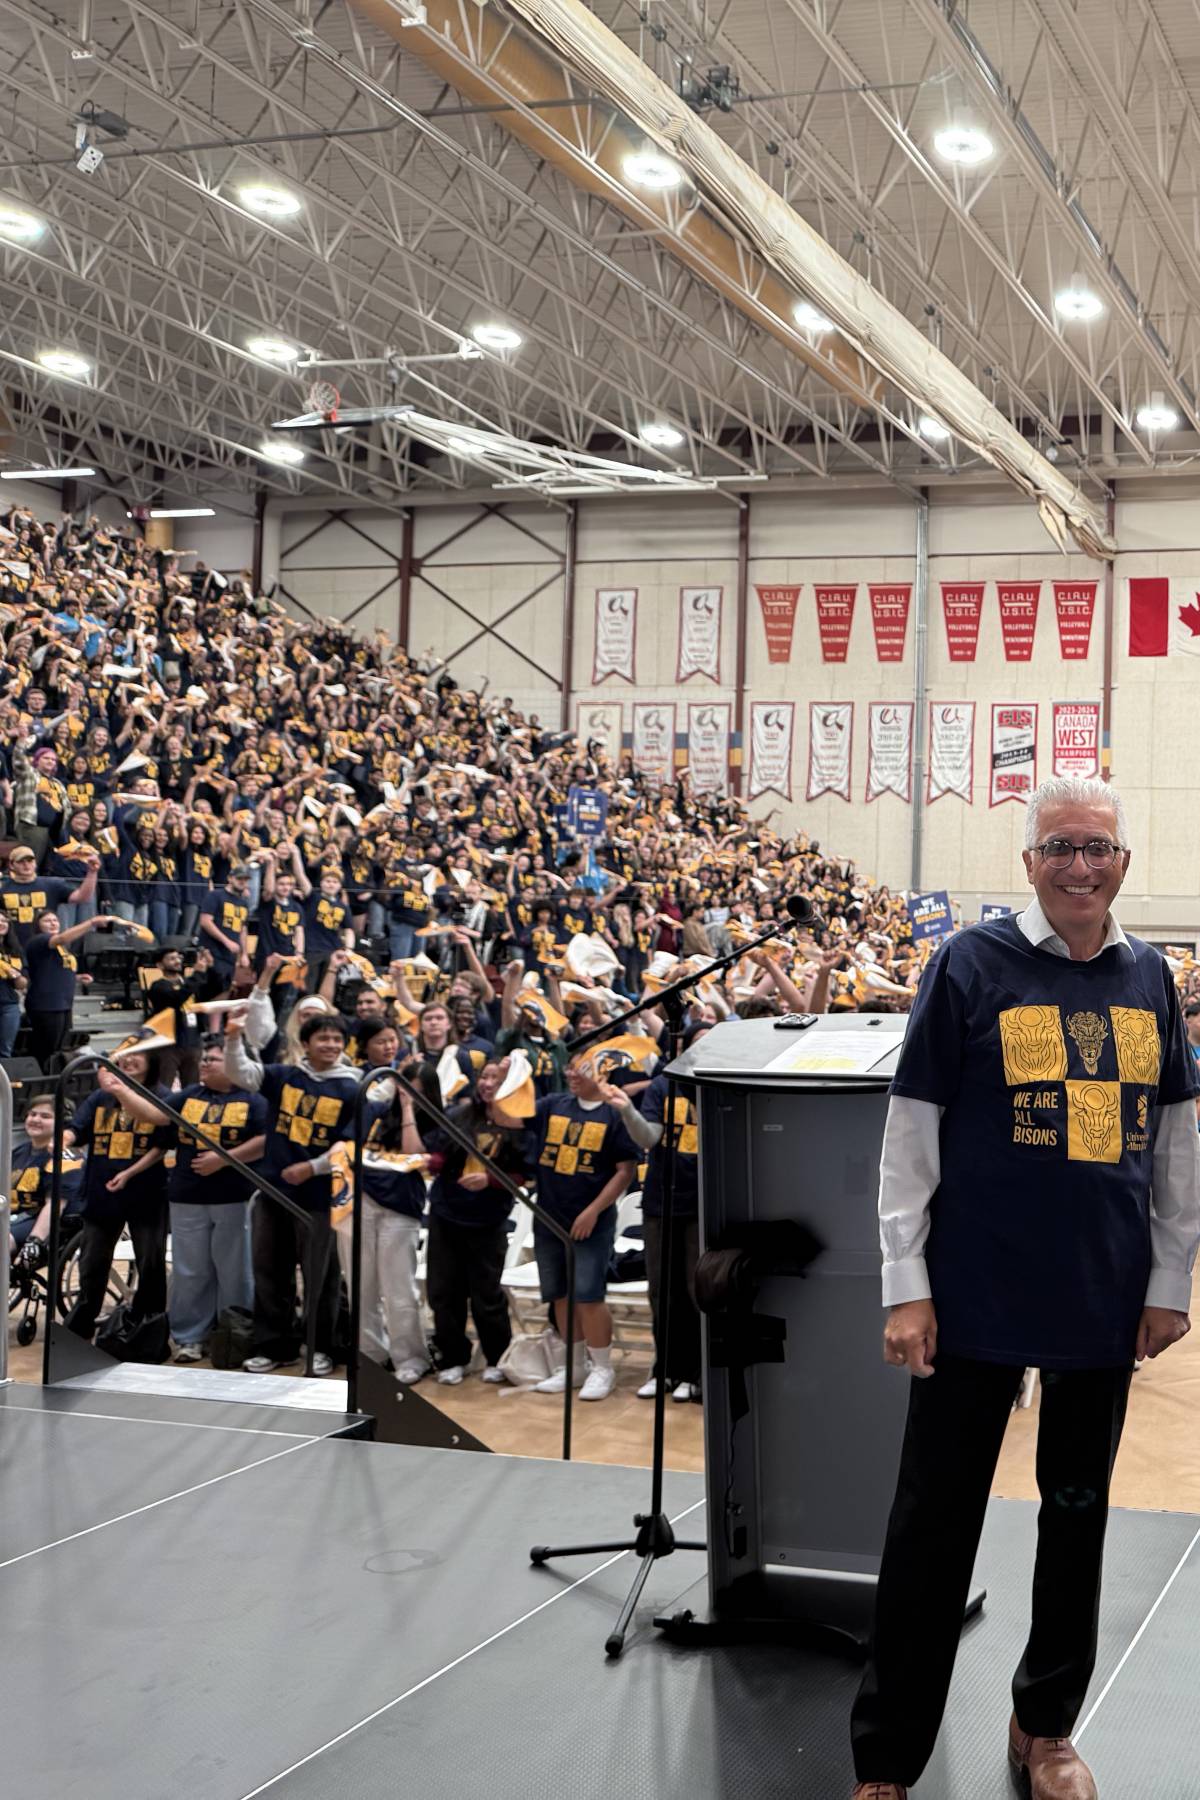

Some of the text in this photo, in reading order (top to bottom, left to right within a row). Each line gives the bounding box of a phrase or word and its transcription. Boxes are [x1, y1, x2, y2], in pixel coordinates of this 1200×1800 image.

[997, 710, 1032, 724] CIS
[1059, 706, 1094, 714] 2023-2024
[1057, 716, 1095, 728] CANADA
[1058, 730, 1093, 746] WEST
[995, 754, 1032, 767] CHAMPIONS
[996, 774, 1030, 788] SIC
[921, 897, 935, 906] WE
[913, 902, 947, 917] ARE ALL
[1014, 1091, 1058, 1109] WE ARE
[1015, 1110, 1036, 1126] ALL
[1013, 1126, 1058, 1146] BISONS
